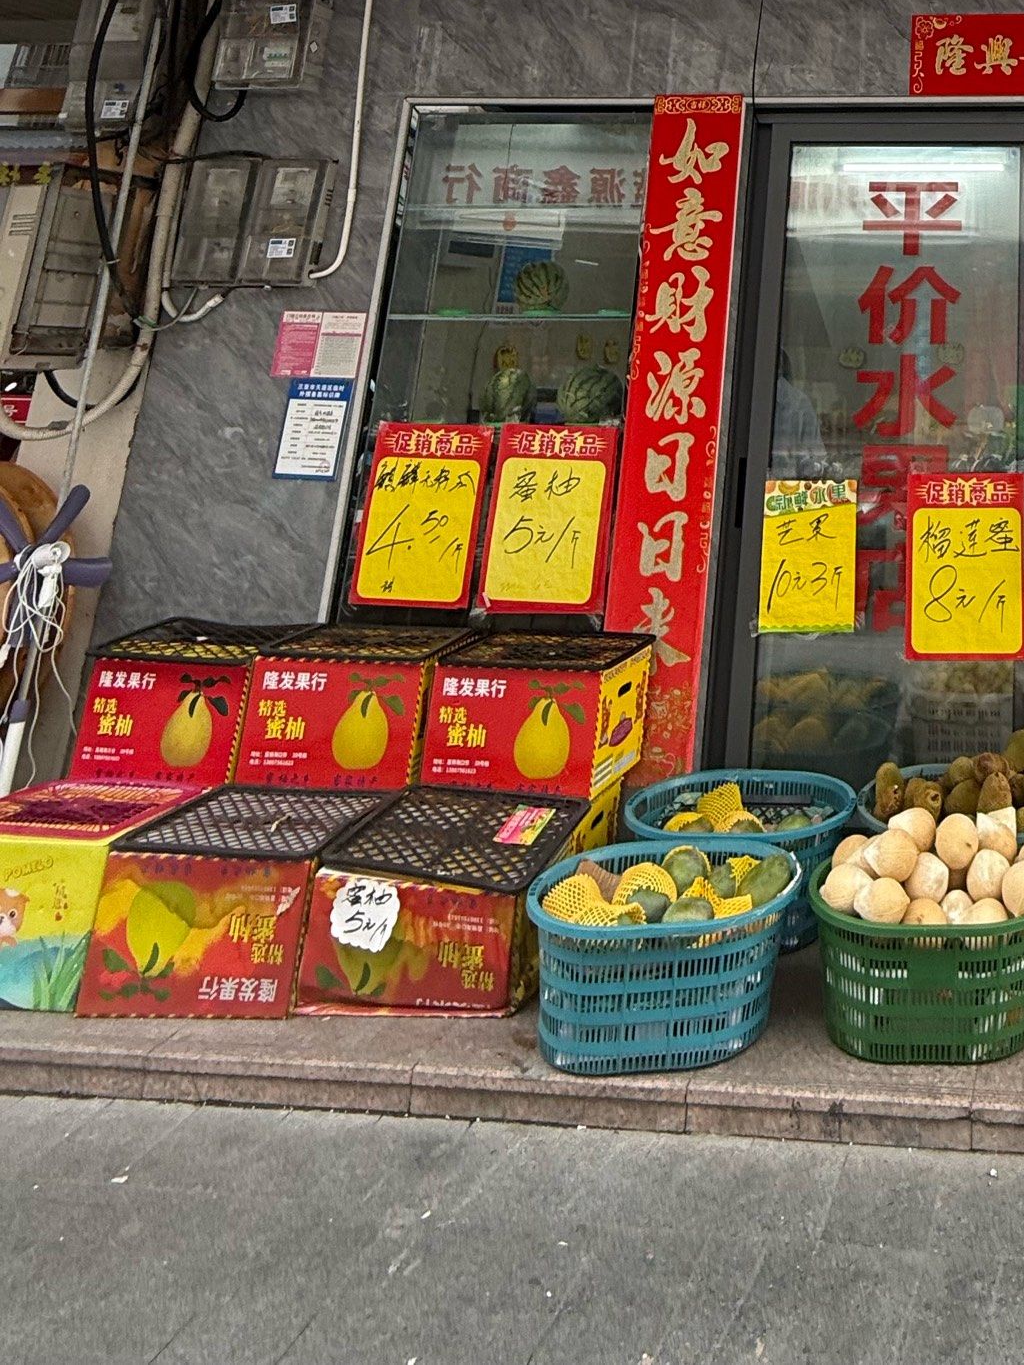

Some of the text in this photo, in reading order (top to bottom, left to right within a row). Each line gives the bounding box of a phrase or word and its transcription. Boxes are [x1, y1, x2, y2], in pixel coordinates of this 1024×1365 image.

[392, 432, 476, 456] 促销商品
[516, 432, 599, 456] 促销商品
[925, 481, 1012, 505] 促销商品
[98, 669, 157, 691] 隆发果行
[262, 670, 328, 692] 隆发果行
[442, 677, 508, 699] 隆发果行
[92, 696, 119, 715] 精选
[257, 698, 288, 718] 精选
[438, 705, 468, 725] 精选
[96, 714, 134, 737] 蜜柚
[264, 716, 306, 741] 蜜柚
[446, 723, 488, 749] 蜜柚
[197, 976, 279, 1004] 隆发果行
